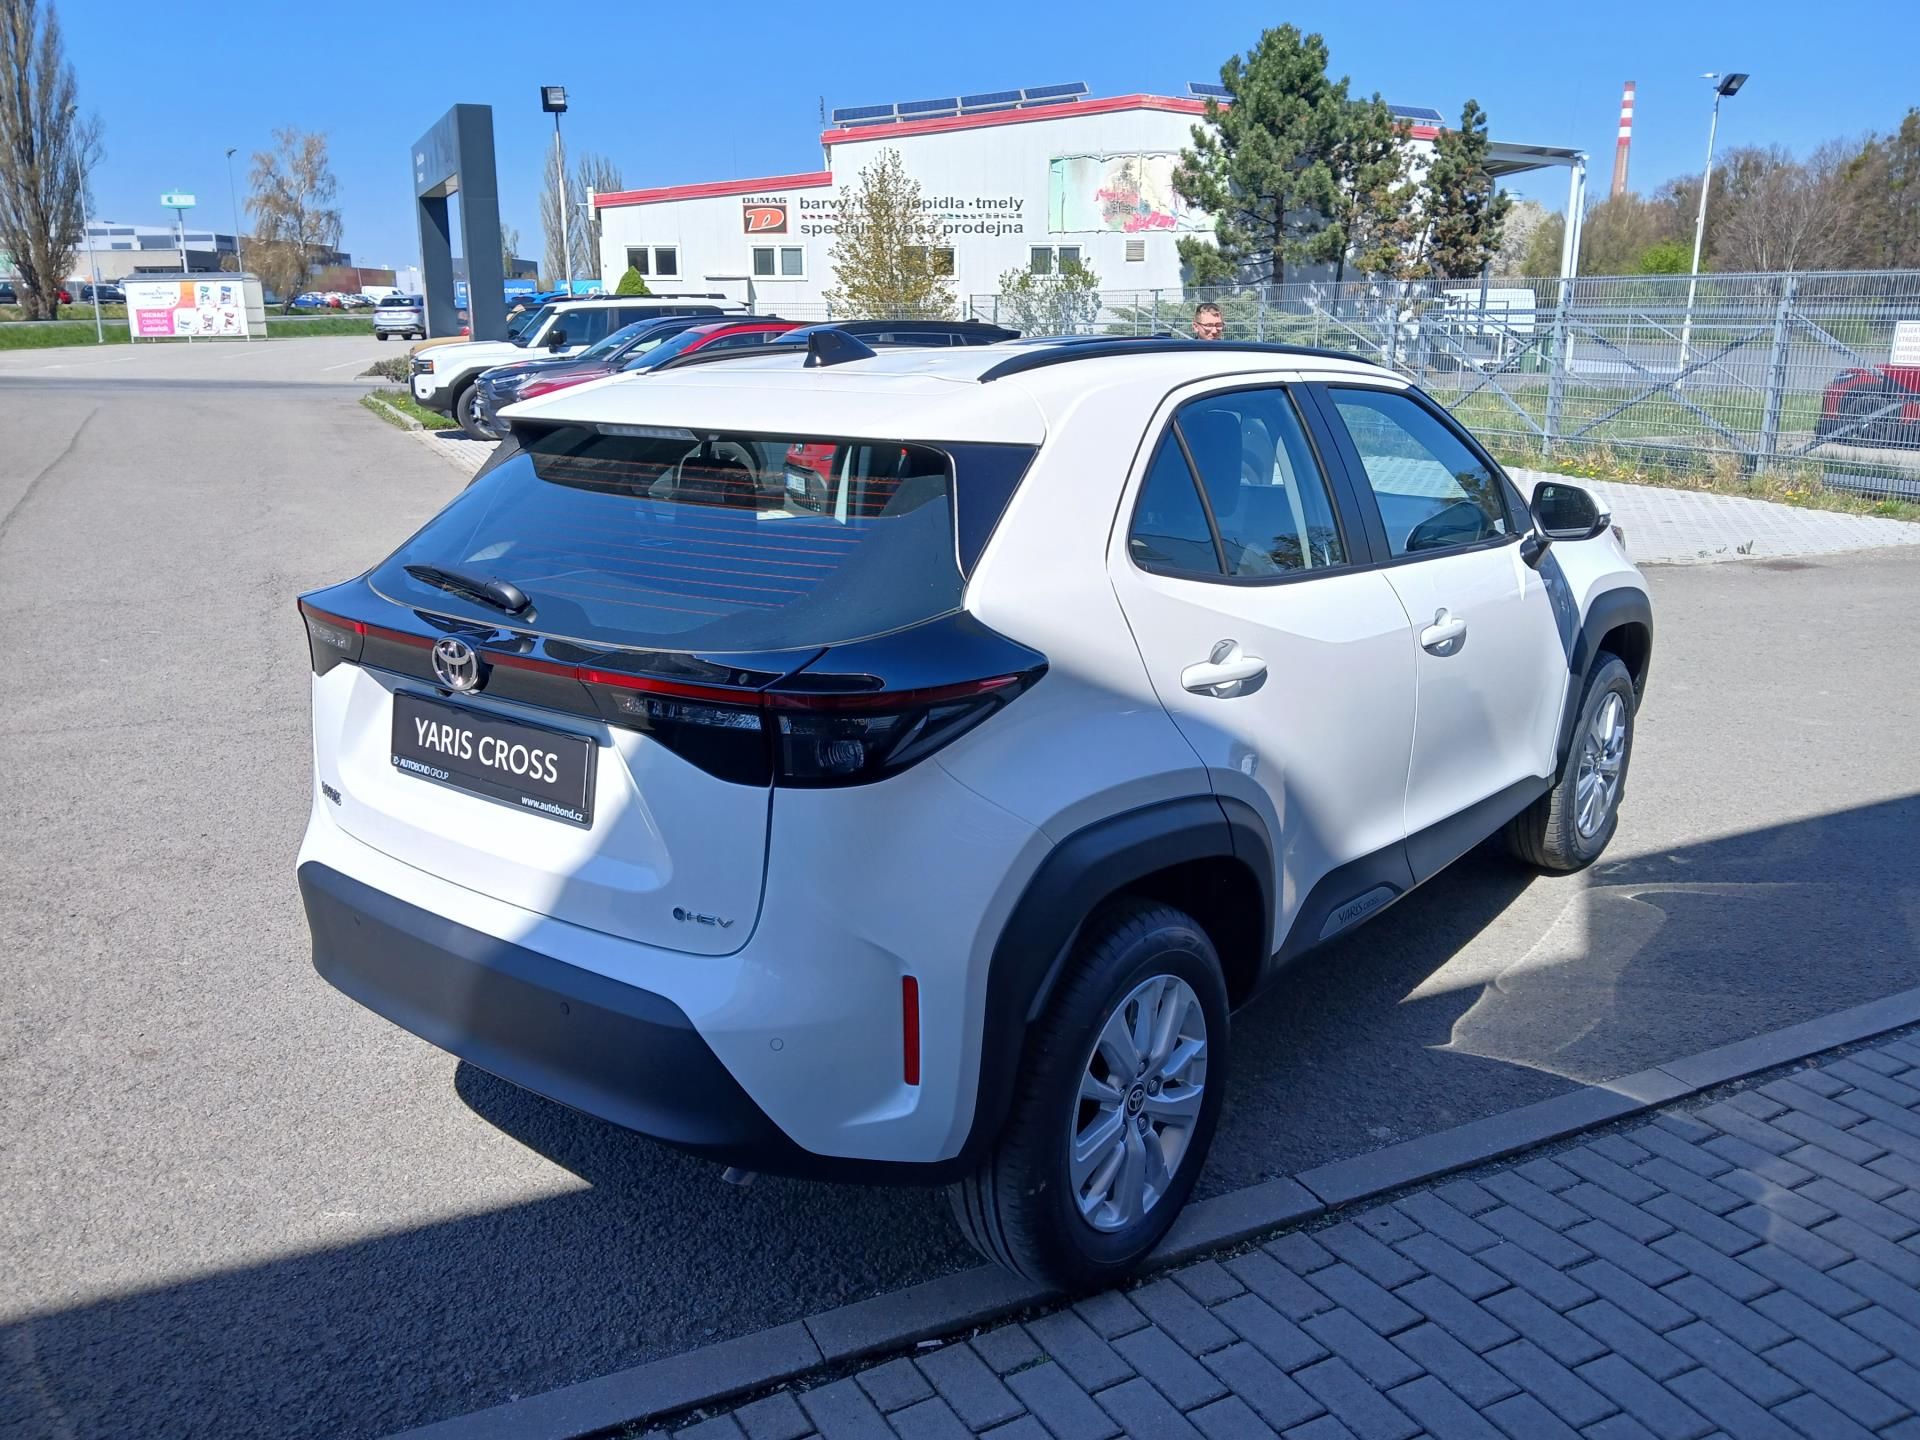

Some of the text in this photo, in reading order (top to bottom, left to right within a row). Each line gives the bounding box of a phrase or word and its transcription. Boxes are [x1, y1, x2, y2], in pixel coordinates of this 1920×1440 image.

[799, 197, 847, 211] barvy
[906, 197, 964, 212] lepidla
[976, 197, 1024, 212] tmely
[943, 221, 1024, 237] prodejna
[415, 717, 558, 784] YARIS CROSS
[400, 758, 449, 780] AUTOBOND GROUP
[521, 796, 583, 822] www.autobond.cz
